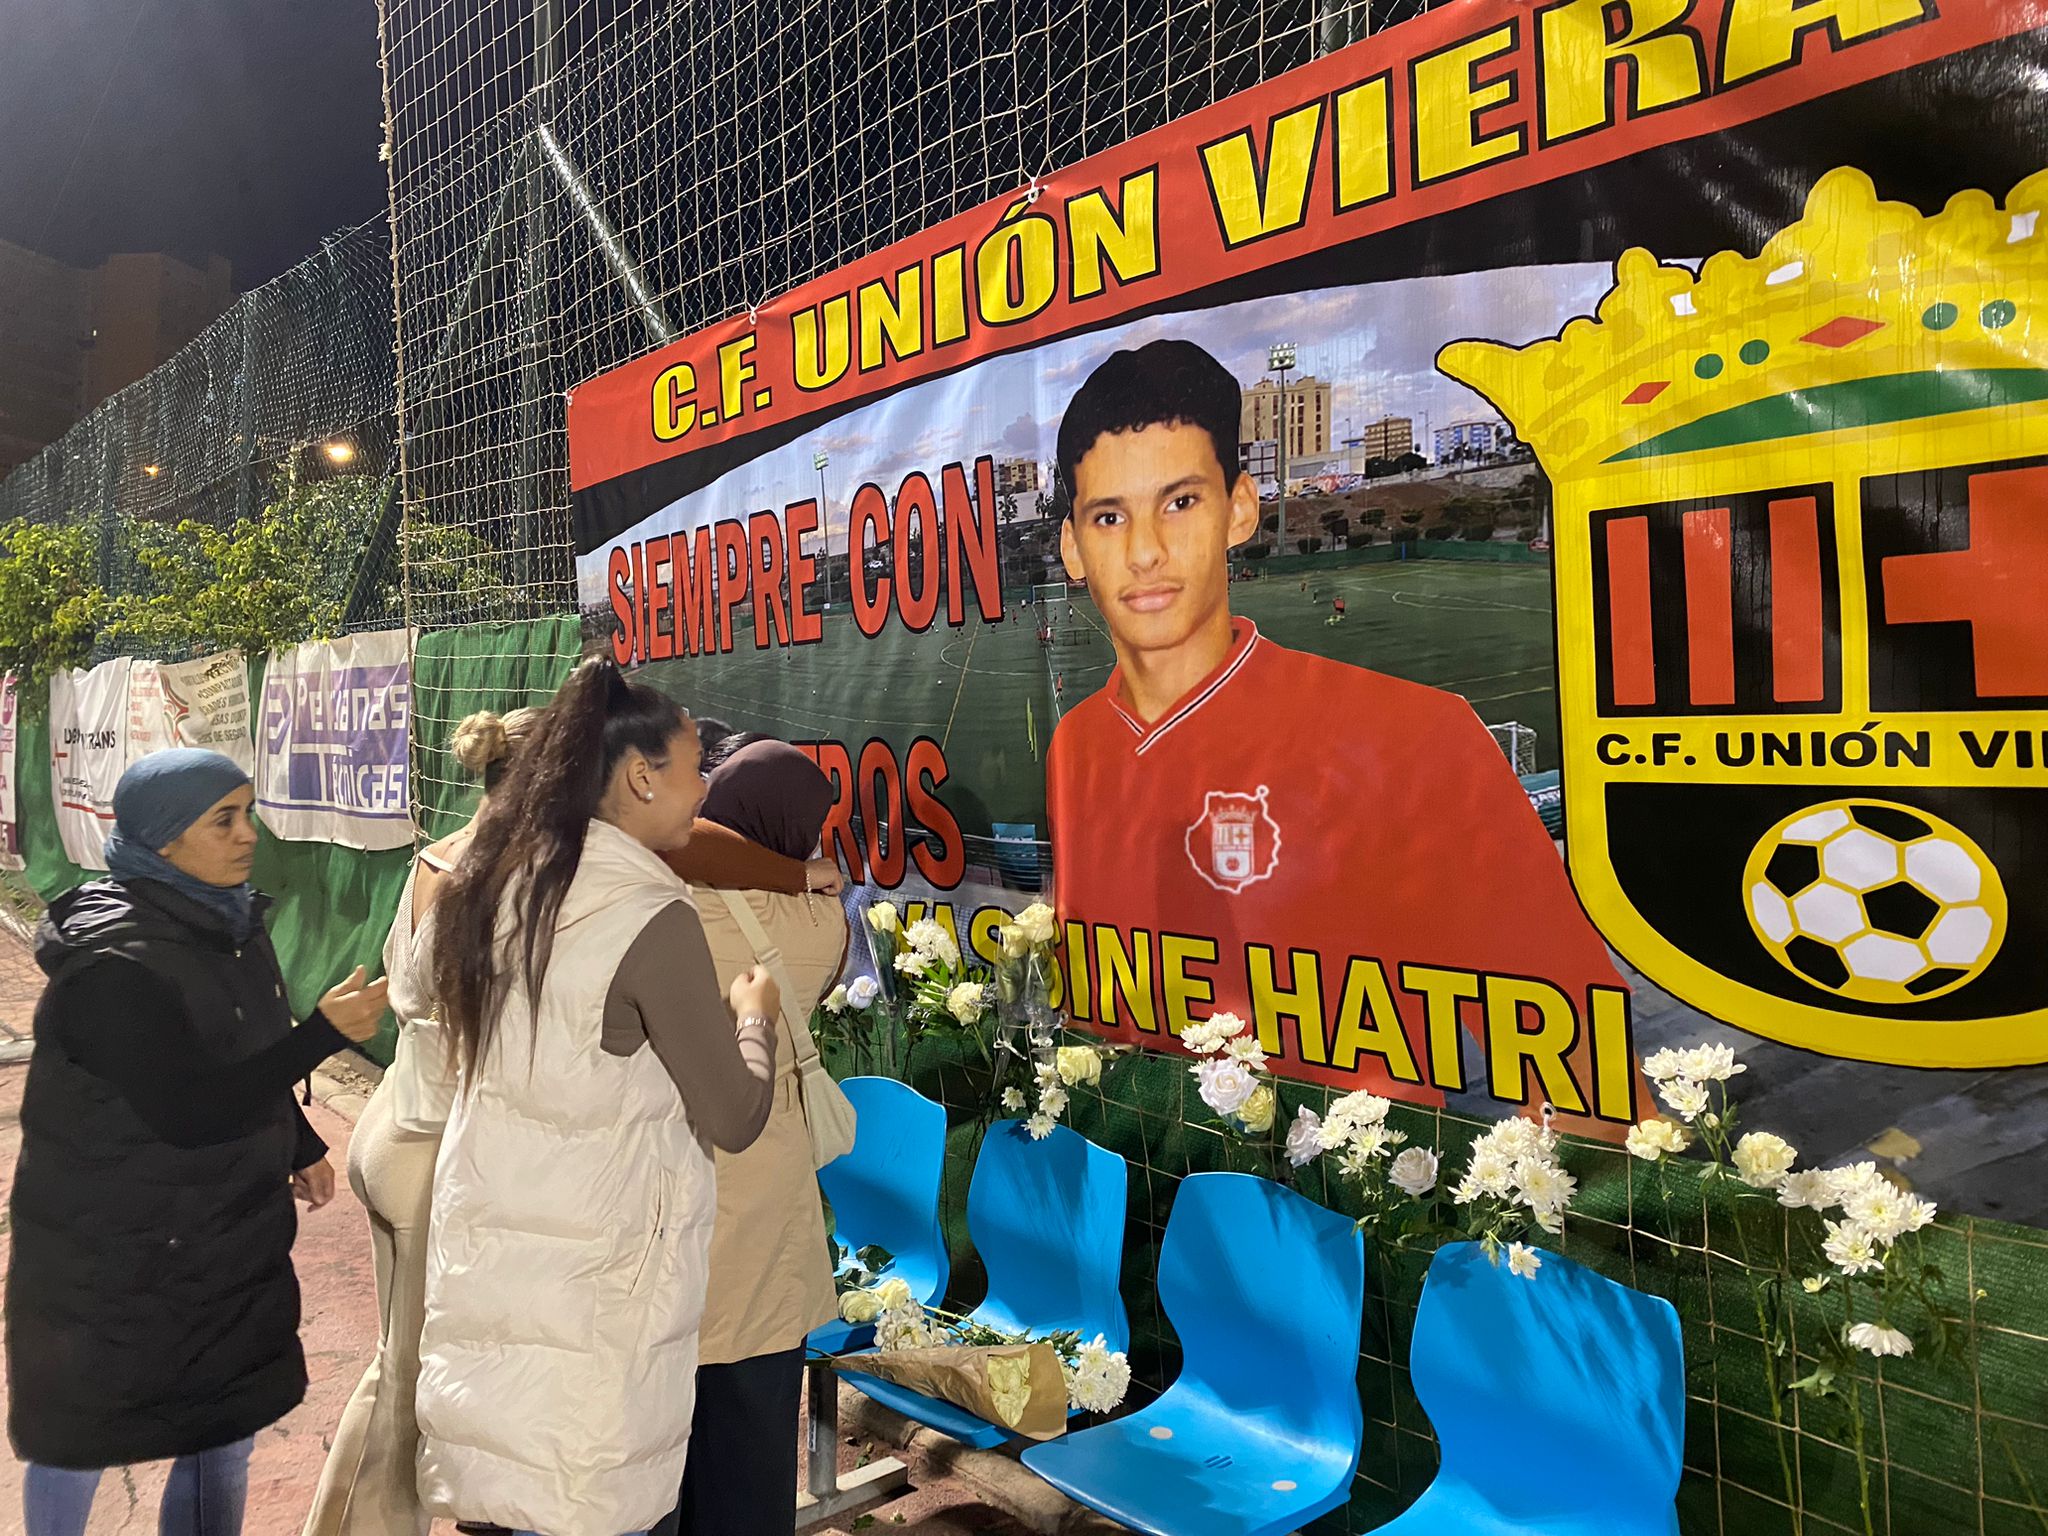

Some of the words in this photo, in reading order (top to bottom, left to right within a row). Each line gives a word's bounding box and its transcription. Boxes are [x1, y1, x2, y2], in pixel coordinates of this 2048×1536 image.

[652, 333, 773, 443] C.F.
[792, 163, 1162, 391] UNIÓN
[1197, 0, 1941, 251] VIERA
[607, 498, 823, 668] SIEMPRE
[848, 454, 1005, 639] CON
[1596, 732, 1697, 768] C.F.
[1715, 721, 1931, 769] UNIÓN
[1958, 730, 2048, 769] VI
[882, 900, 1219, 1037] YASINE
[1244, 942, 1638, 1125] HATRI
